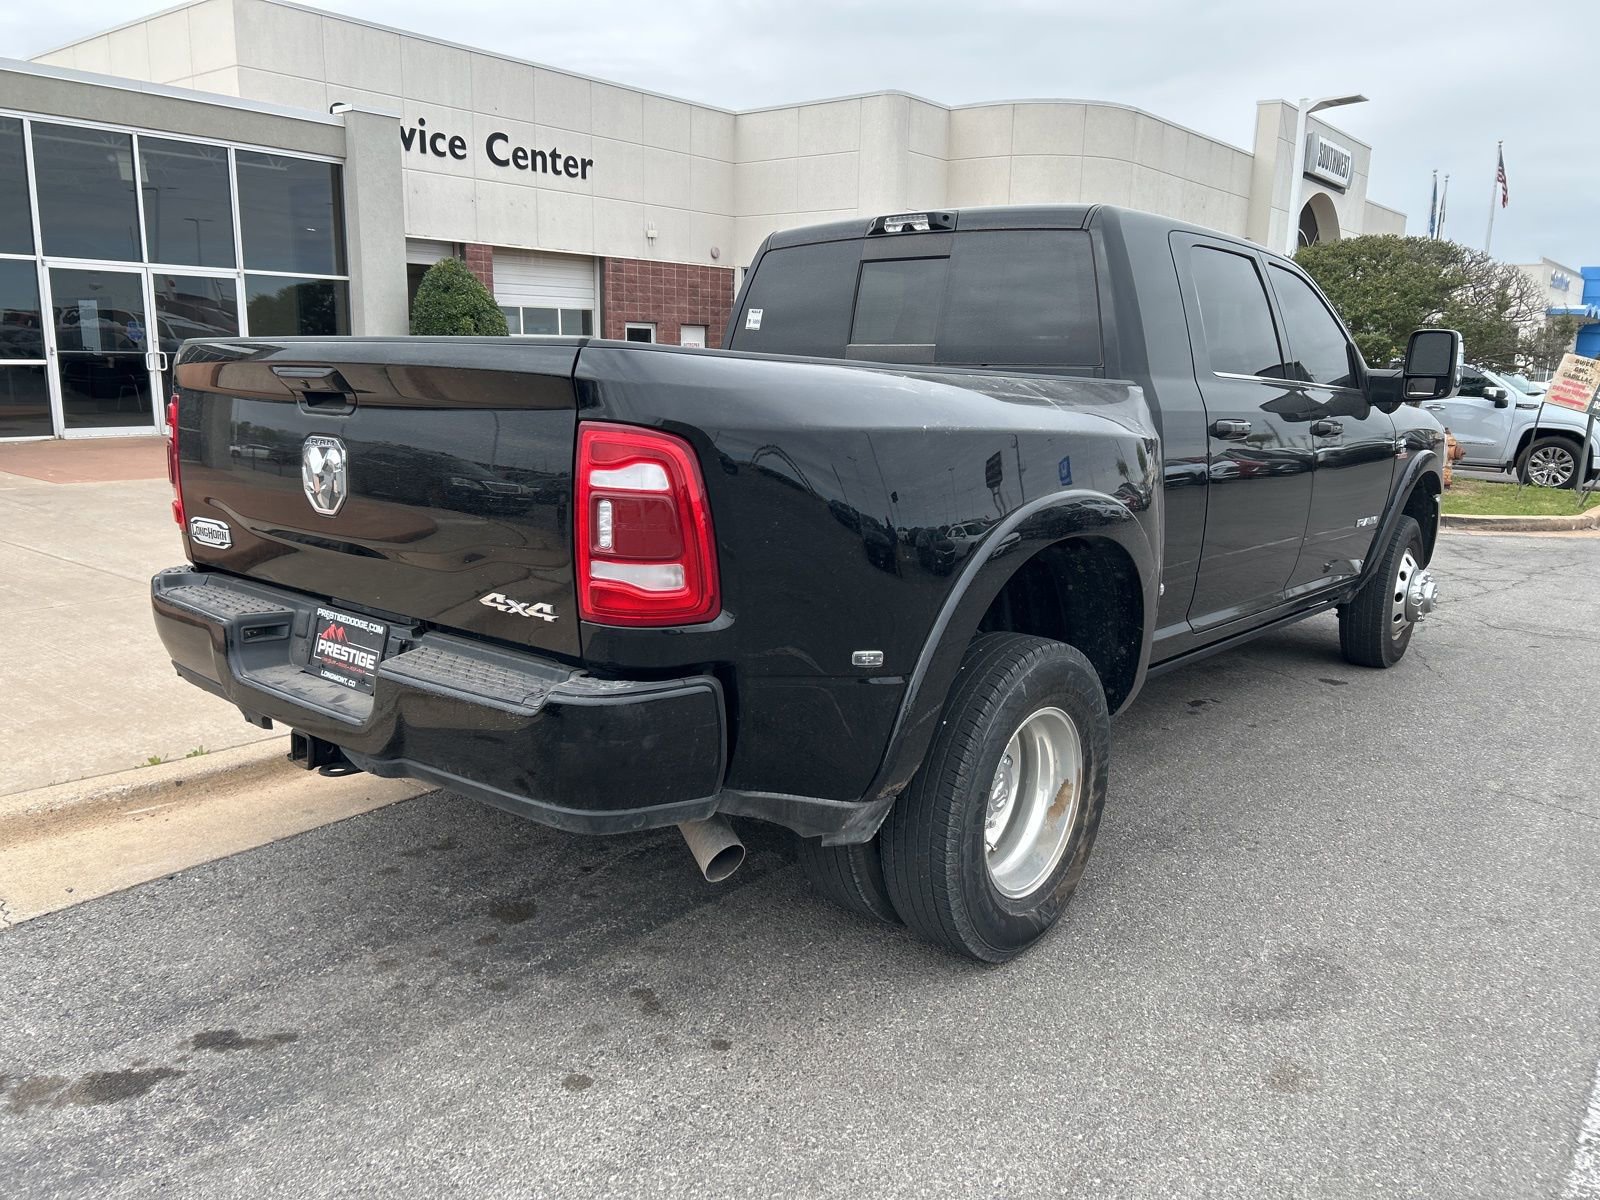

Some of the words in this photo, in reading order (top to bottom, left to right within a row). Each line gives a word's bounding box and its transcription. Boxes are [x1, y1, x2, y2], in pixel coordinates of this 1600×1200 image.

[485, 131, 594, 180] Center
[1317, 141, 1351, 180] SOUTHWEST
[1562, 371, 1594, 385] CADILLAC
[1572, 366, 1589, 375] GMC
[310, 437, 336, 446] RAM
[191, 523, 228, 542] LONGHORN
[316, 607, 384, 635] PRESTIGEDODGE.COM
[317, 639, 377, 670] PRESTIGE
[347, 679, 357, 688] CO
